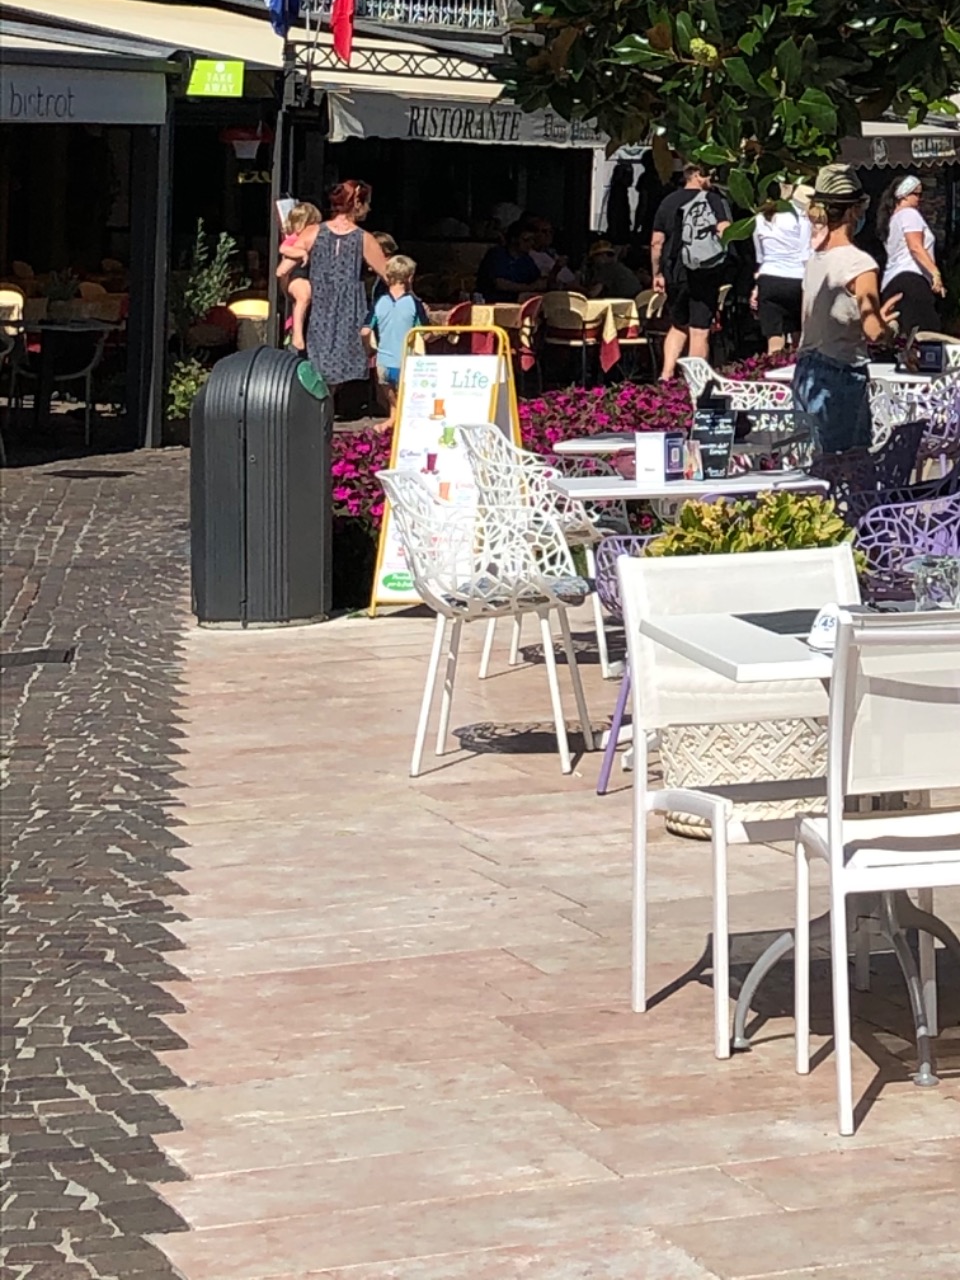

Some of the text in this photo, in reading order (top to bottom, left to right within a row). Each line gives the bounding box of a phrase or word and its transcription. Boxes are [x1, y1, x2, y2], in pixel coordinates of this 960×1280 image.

[206, 72, 233, 82] TAKE
[203, 83, 235, 94] AWAY
[407, 105, 522, 141] RISTORANTE
[451, 368, 489, 389] Life
